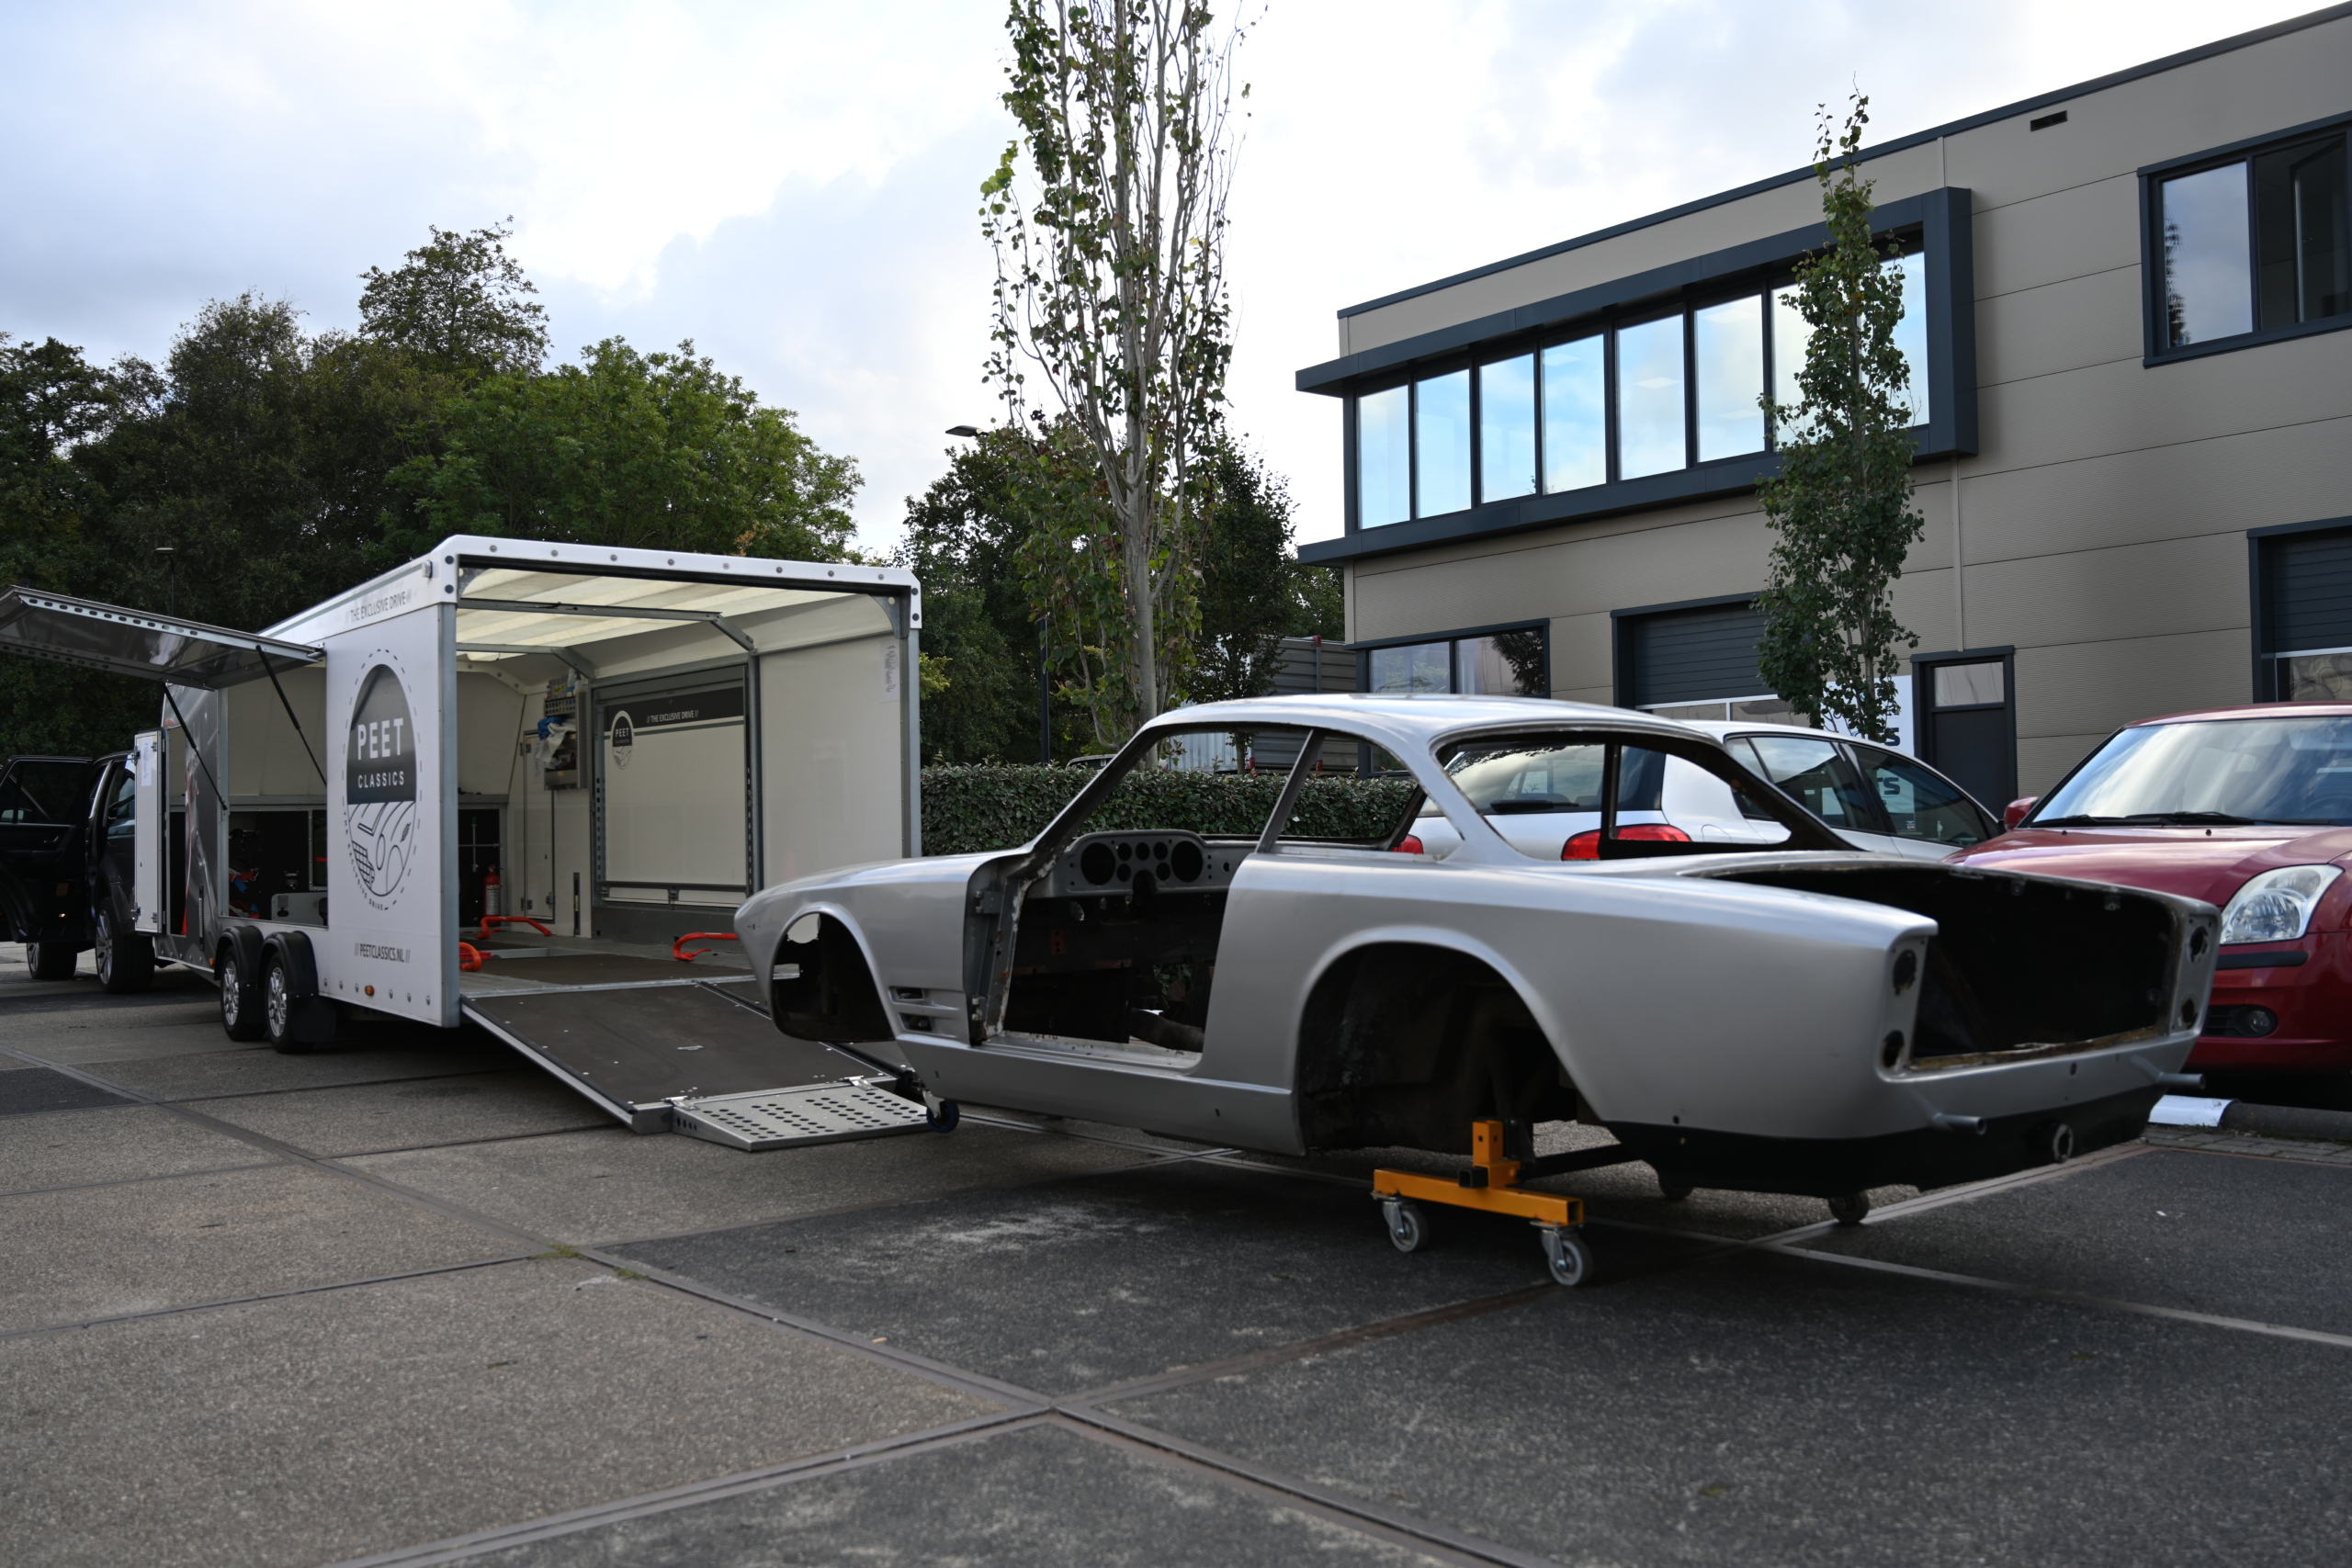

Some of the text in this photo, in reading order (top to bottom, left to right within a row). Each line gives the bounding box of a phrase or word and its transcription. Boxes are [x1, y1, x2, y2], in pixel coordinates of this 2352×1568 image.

[350, 607, 360, 623] THE
[361, 598, 388, 619] EXCLUSIVE
[390, 591, 406, 609] DRIVE
[659, 712, 681, 722] EXCLUSIVE
[681, 711, 694, 719] DRIVE
[357, 717, 404, 761] PEET
[615, 728, 629, 738] PEET
[357, 771, 404, 788] CLASSICS
[360, 943, 405, 963] PEETCLASSICS.NL
